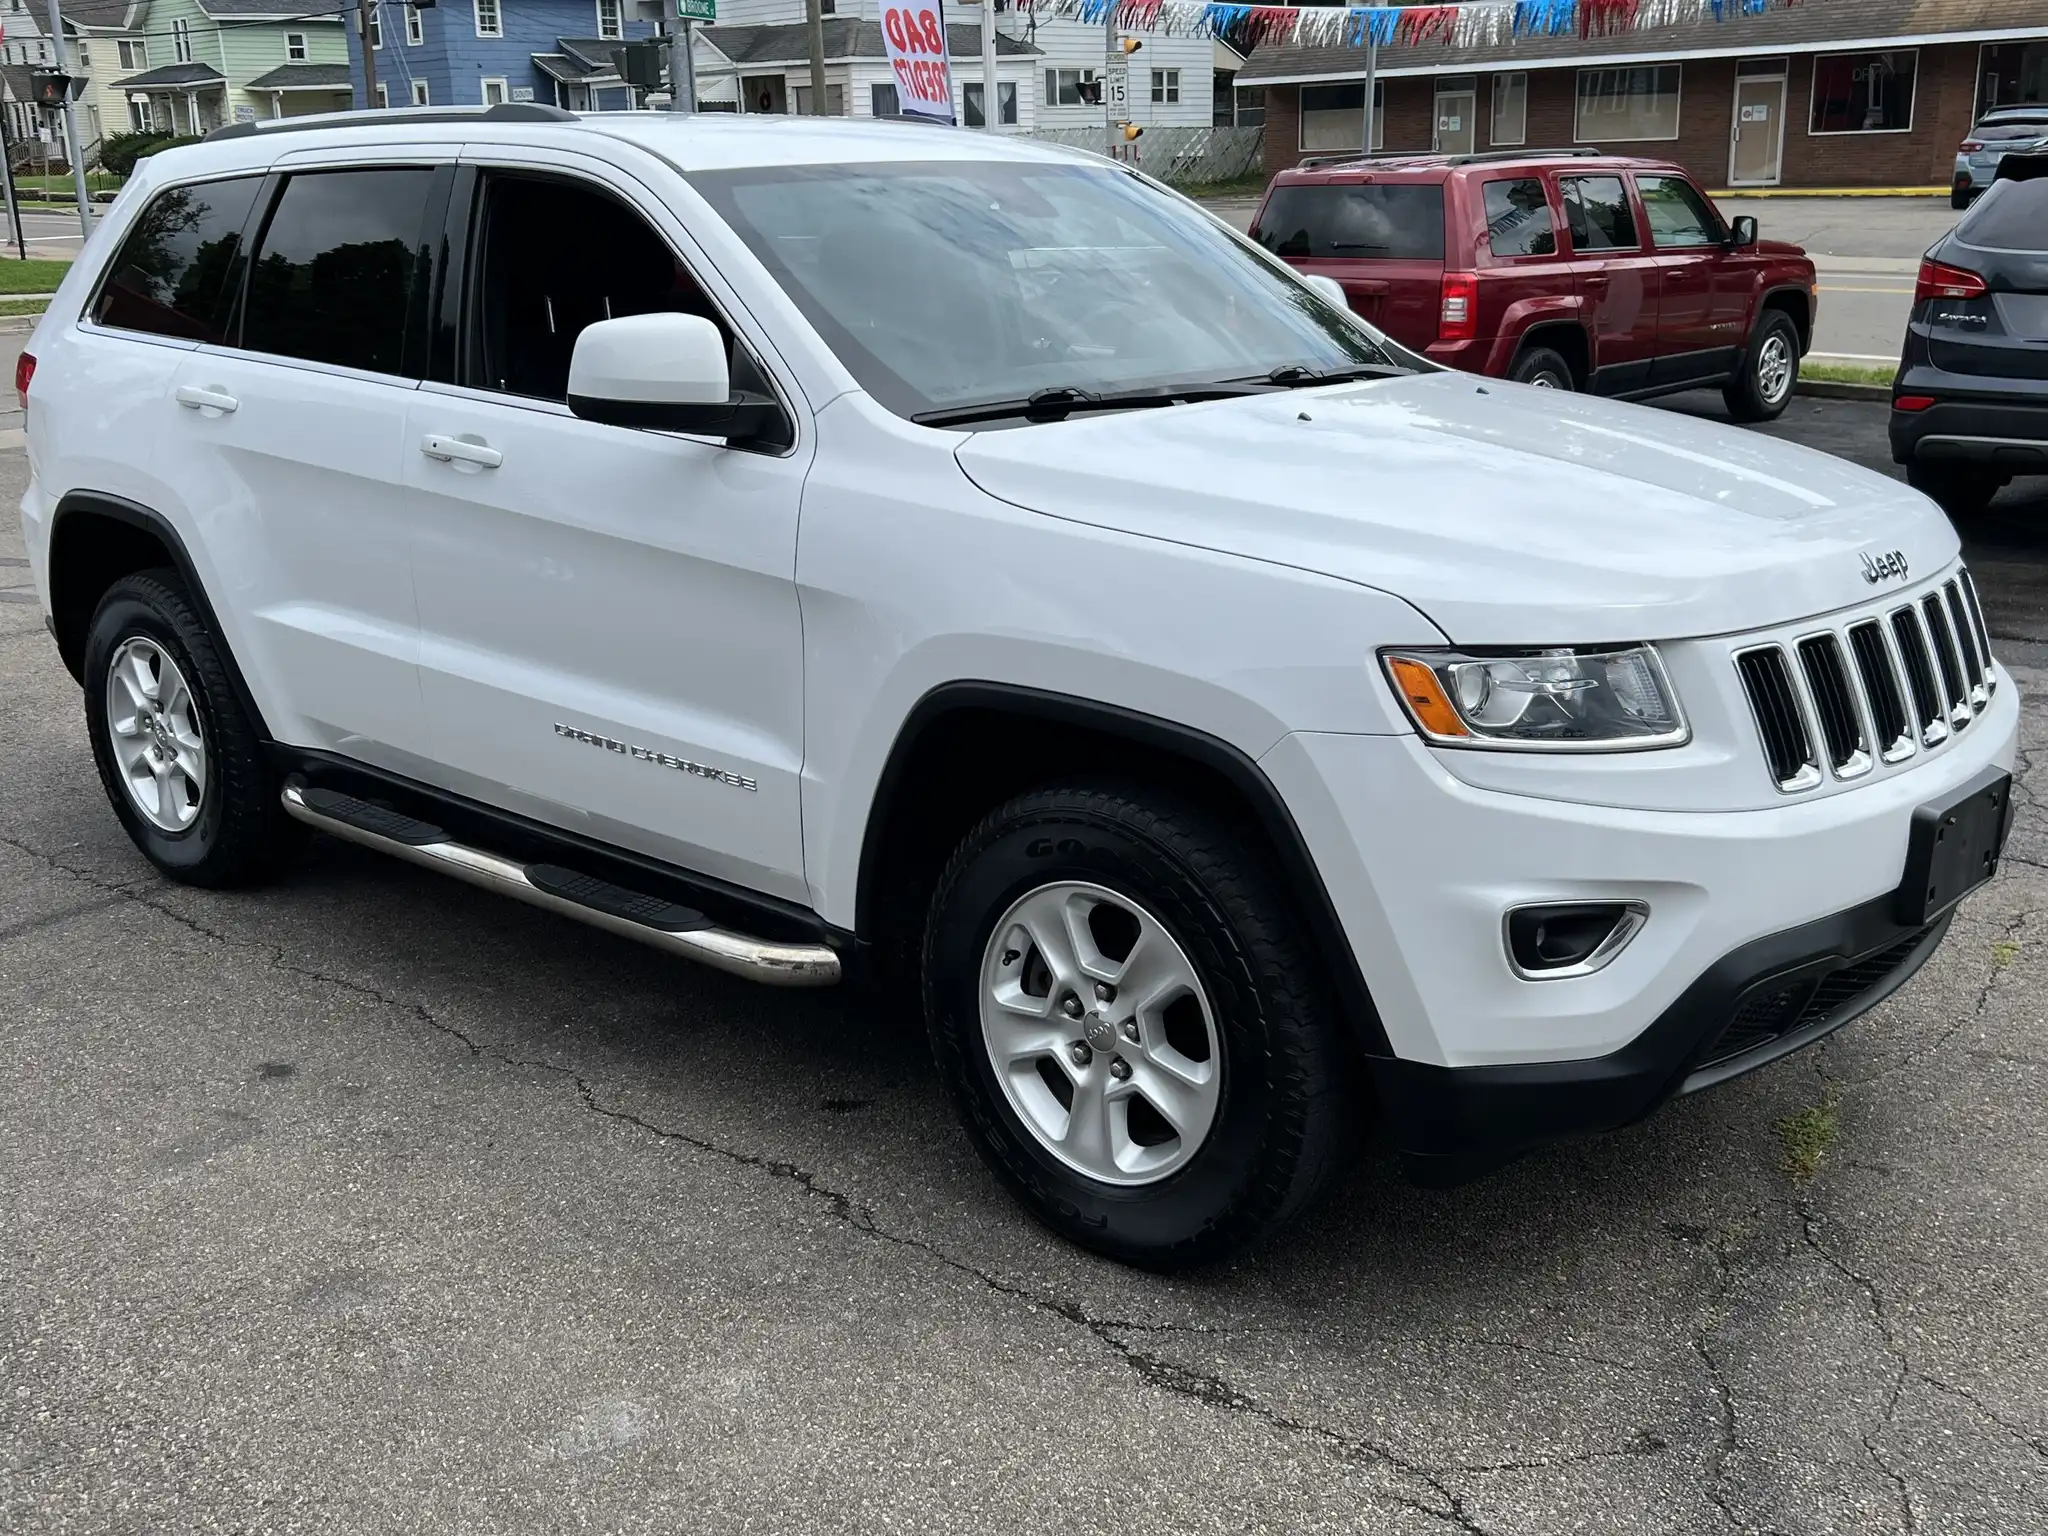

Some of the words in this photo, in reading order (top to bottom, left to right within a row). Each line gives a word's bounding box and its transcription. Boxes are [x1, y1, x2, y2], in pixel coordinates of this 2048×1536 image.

[1108, 67, 1126, 75] SPEED
[1110, 76, 1125, 84] LIMIT
[1111, 86, 1125, 101] 15
[1859, 550, 1908, 585] Jeep
[554, 722, 627, 754] GRAND
[630, 744, 758, 792] CHEROKEE
